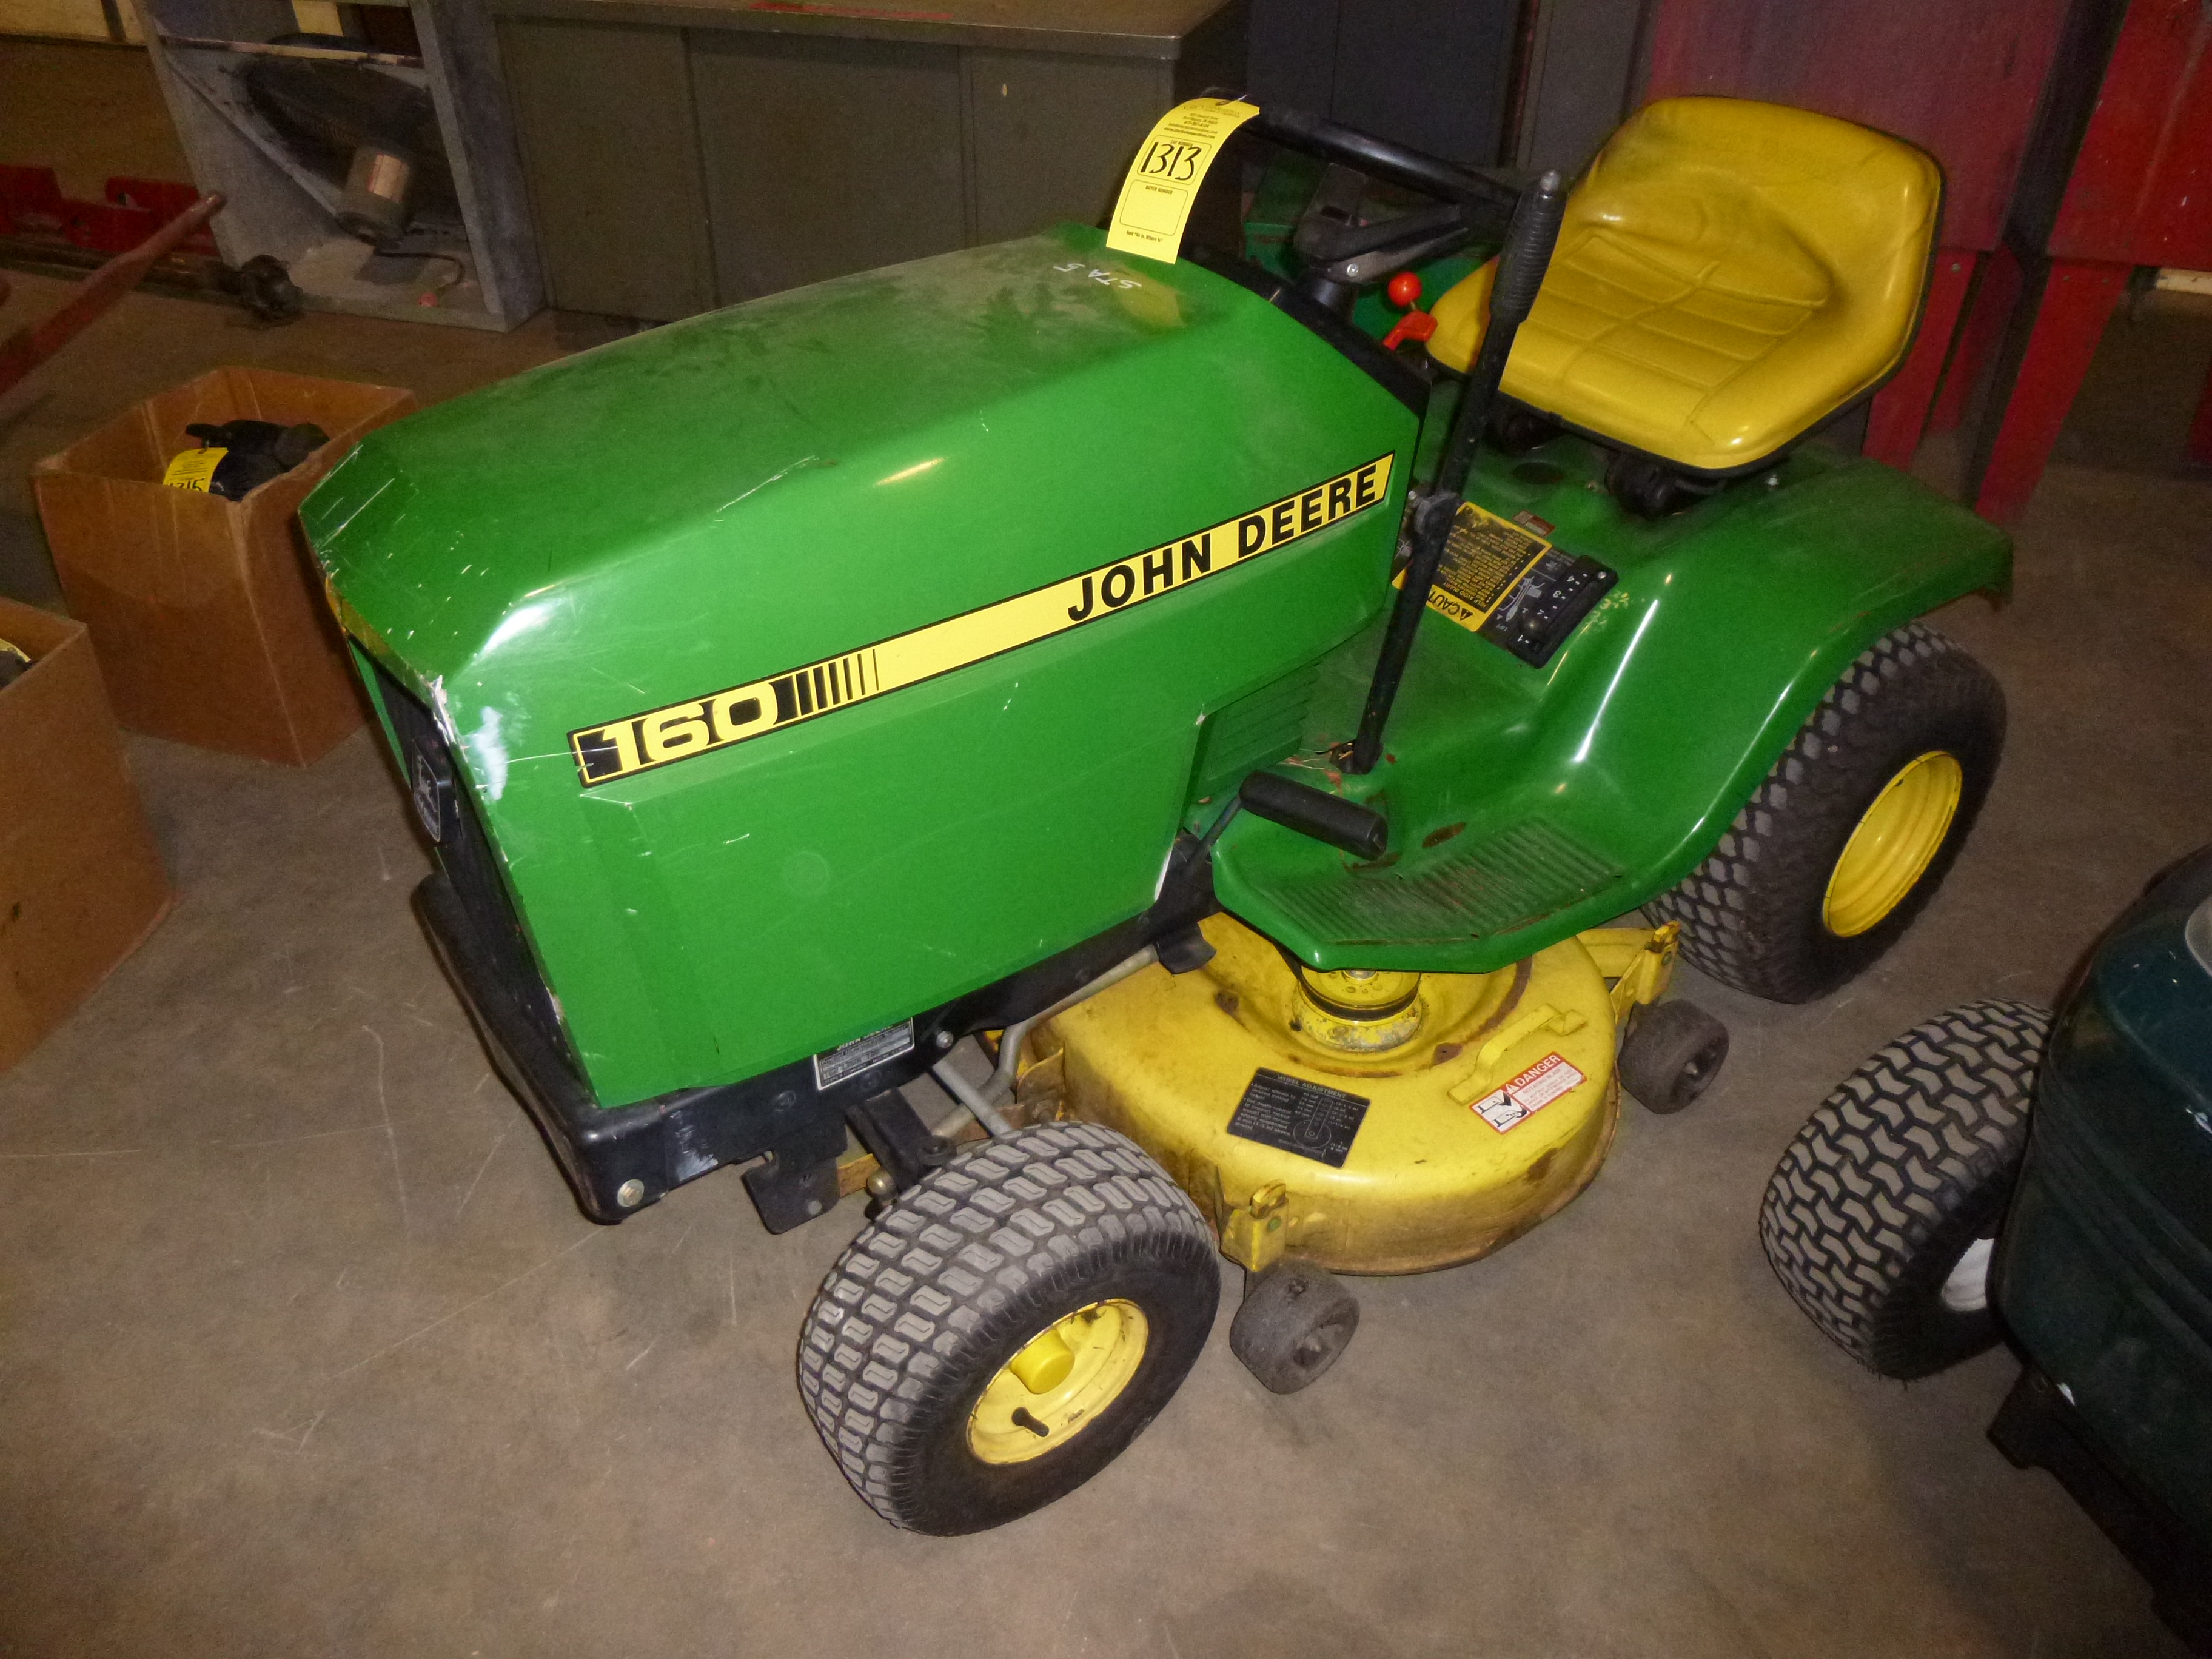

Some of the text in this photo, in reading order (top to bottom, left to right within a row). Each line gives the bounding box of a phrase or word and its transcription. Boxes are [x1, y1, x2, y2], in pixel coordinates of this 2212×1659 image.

[1140, 141, 1202, 181] 1313
[170, 478, 206, 492] 15
[1068, 464, 1376, 622] JOHN DEERE
[1566, 574, 1576, 583] 4
[1427, 589, 1461, 615] CAUT
[1442, 581, 1487, 608] HELP AVOID INJURY
[1551, 589, 1563, 598] 3
[1495, 622, 1509, 632] LIFT
[1515, 634, 1526, 643] 1
[602, 682, 778, 771] 160
[1513, 1053, 1561, 1087] DANGER
[1522, 1068, 1561, 1094] ROTATING BLADE
[1276, 1074, 1347, 1099] WHEEL ADJUSTMENT
